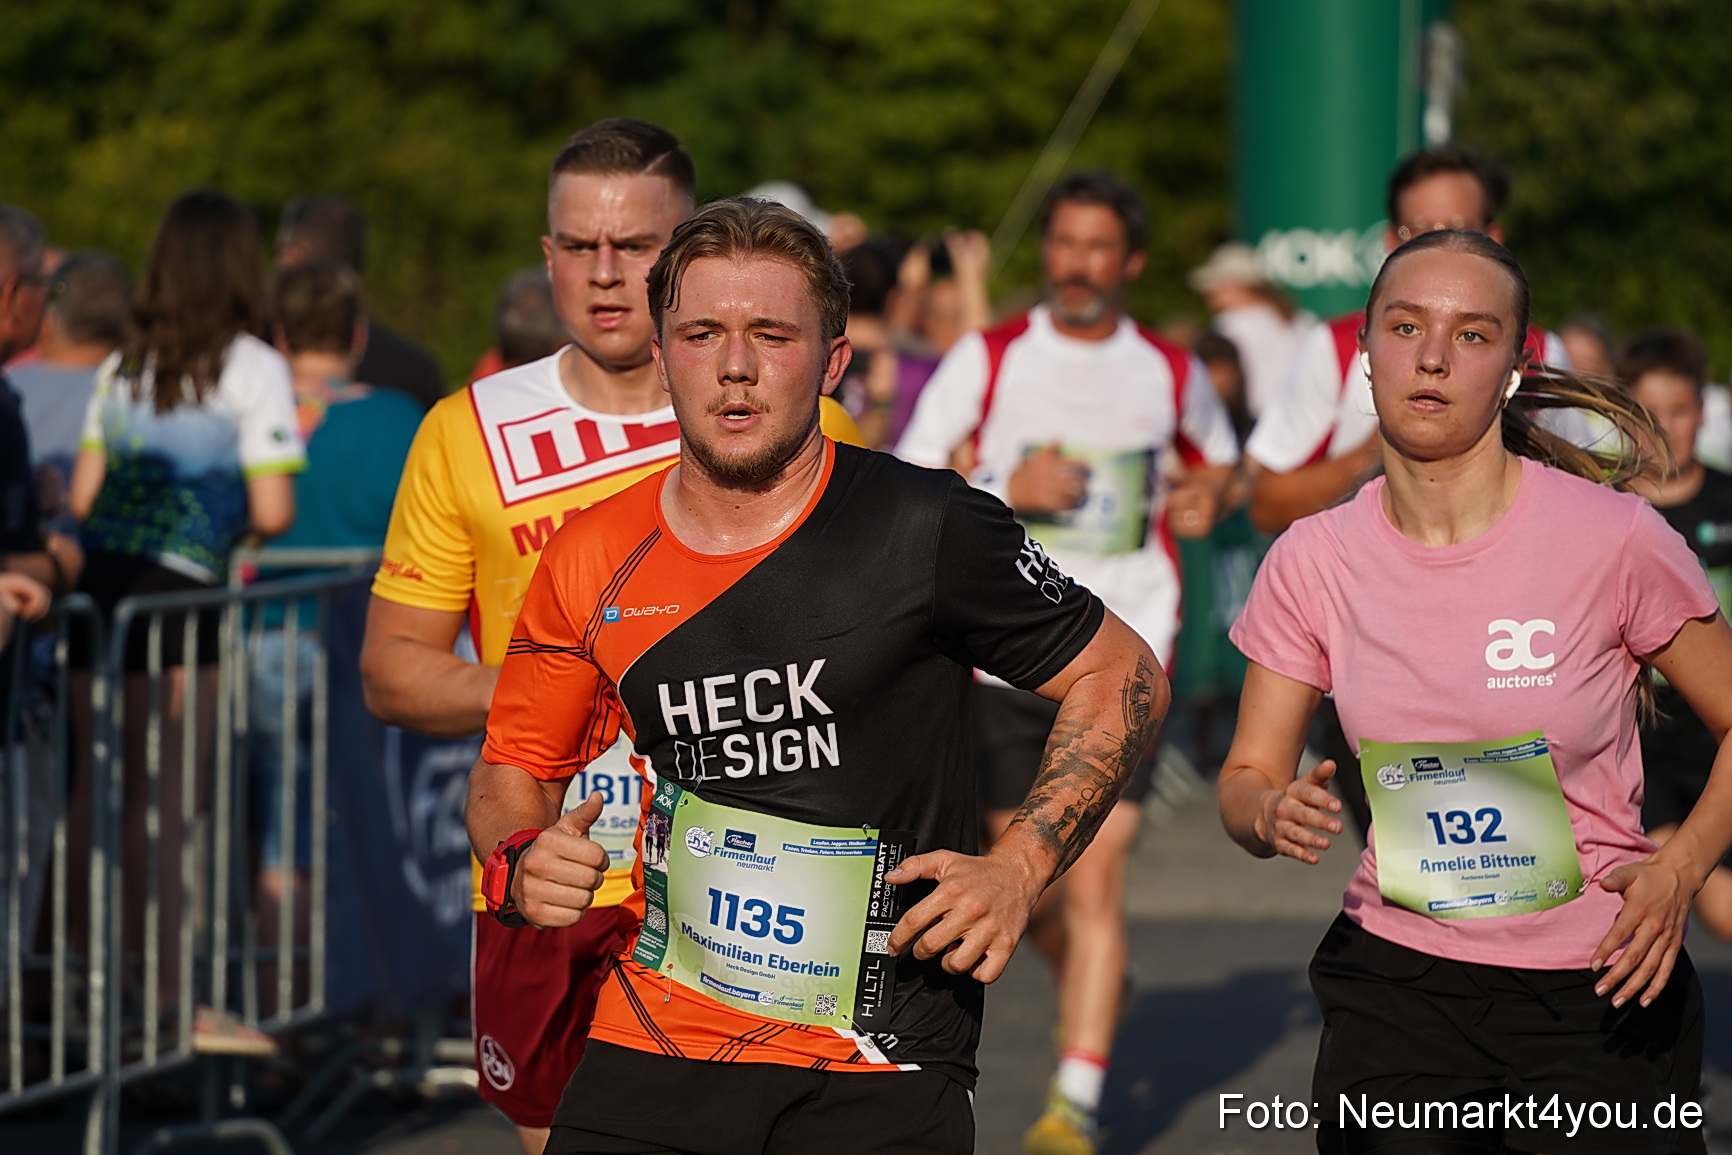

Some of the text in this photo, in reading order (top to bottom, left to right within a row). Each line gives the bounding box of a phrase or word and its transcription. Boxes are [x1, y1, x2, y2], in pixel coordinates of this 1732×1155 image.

[623, 604, 680, 617] owayo
[1485, 618, 1556, 671] ac
[1486, 673, 1555, 689] auctores
[658, 658, 834, 736] HECK
[674, 722, 840, 781] DESIGN
[1410, 768, 1465, 782] Firmenlauf
[578, 771, 643, 805] 1811
[656, 794, 674, 810] AOK
[1426, 807, 1508, 845] 132
[727, 834, 754, 848] Fischer
[713, 846, 777, 865] Firmenlauf
[736, 861, 774, 873] neumarkt
[887, 843, 897, 872] UTLET
[1419, 853, 1537, 873] Amelie Bittner
[870, 842, 888, 918] 20 % RABATT
[1431, 895, 1493, 911] firmenlauf.bayern
[708, 887, 806, 945] 1135
[681, 921, 764, 966] Maximilian
[767, 953, 841, 978] Eberlein
[726, 962, 776, 980] Heck Design GmbH
[702, 975, 756, 1000] firmenlauf.bayern
[861, 960, 880, 1017] HILTL
